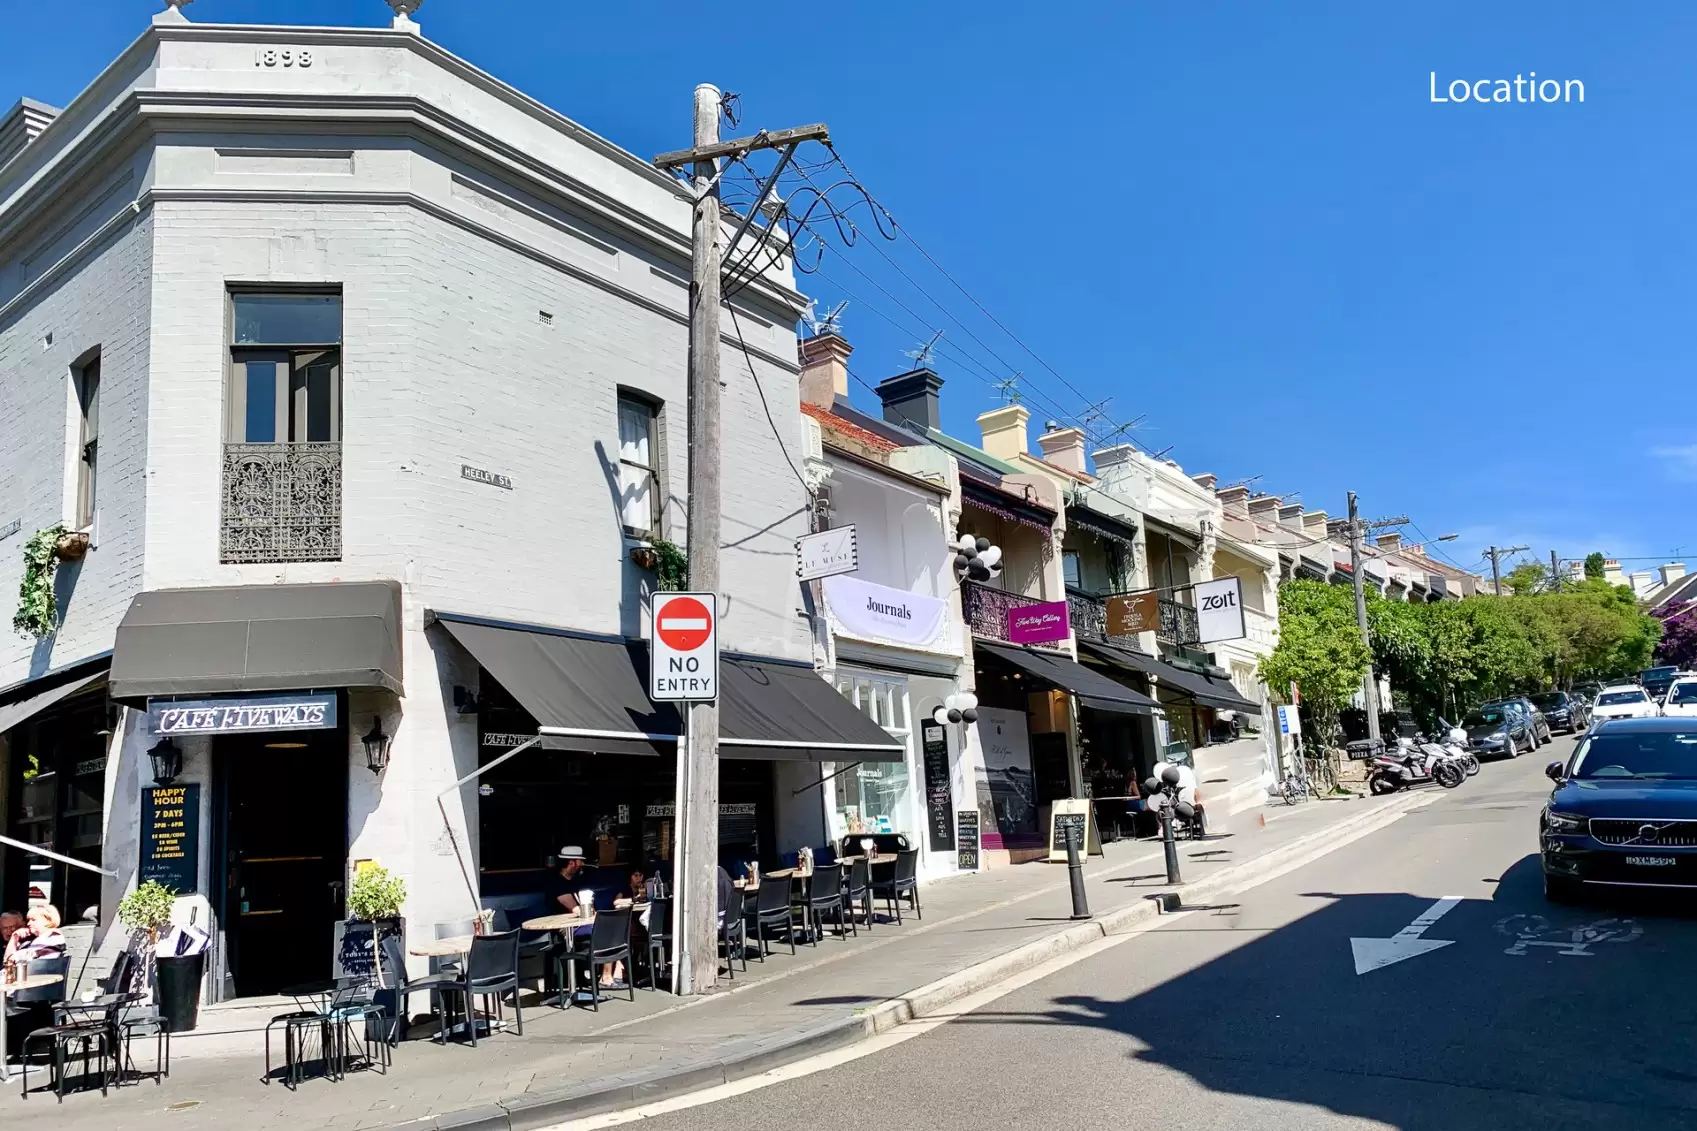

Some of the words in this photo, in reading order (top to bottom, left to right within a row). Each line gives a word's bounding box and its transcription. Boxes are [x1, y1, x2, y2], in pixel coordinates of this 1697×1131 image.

[254, 49, 312, 68] 1898
[464, 466, 495, 482] HEELEY
[866, 596, 912, 620] Journals
[669, 656, 699, 673] NO
[657, 678, 710, 691] ENTRY
[219, 704, 326, 730] FIVEWAYS
[152, 788, 186, 797] HAPPY
[154, 796, 184, 806] HOUR
[154, 810, 161, 819] 7
[163, 809, 183, 818] DAYS
[959, 854, 976, 865] OPEN
